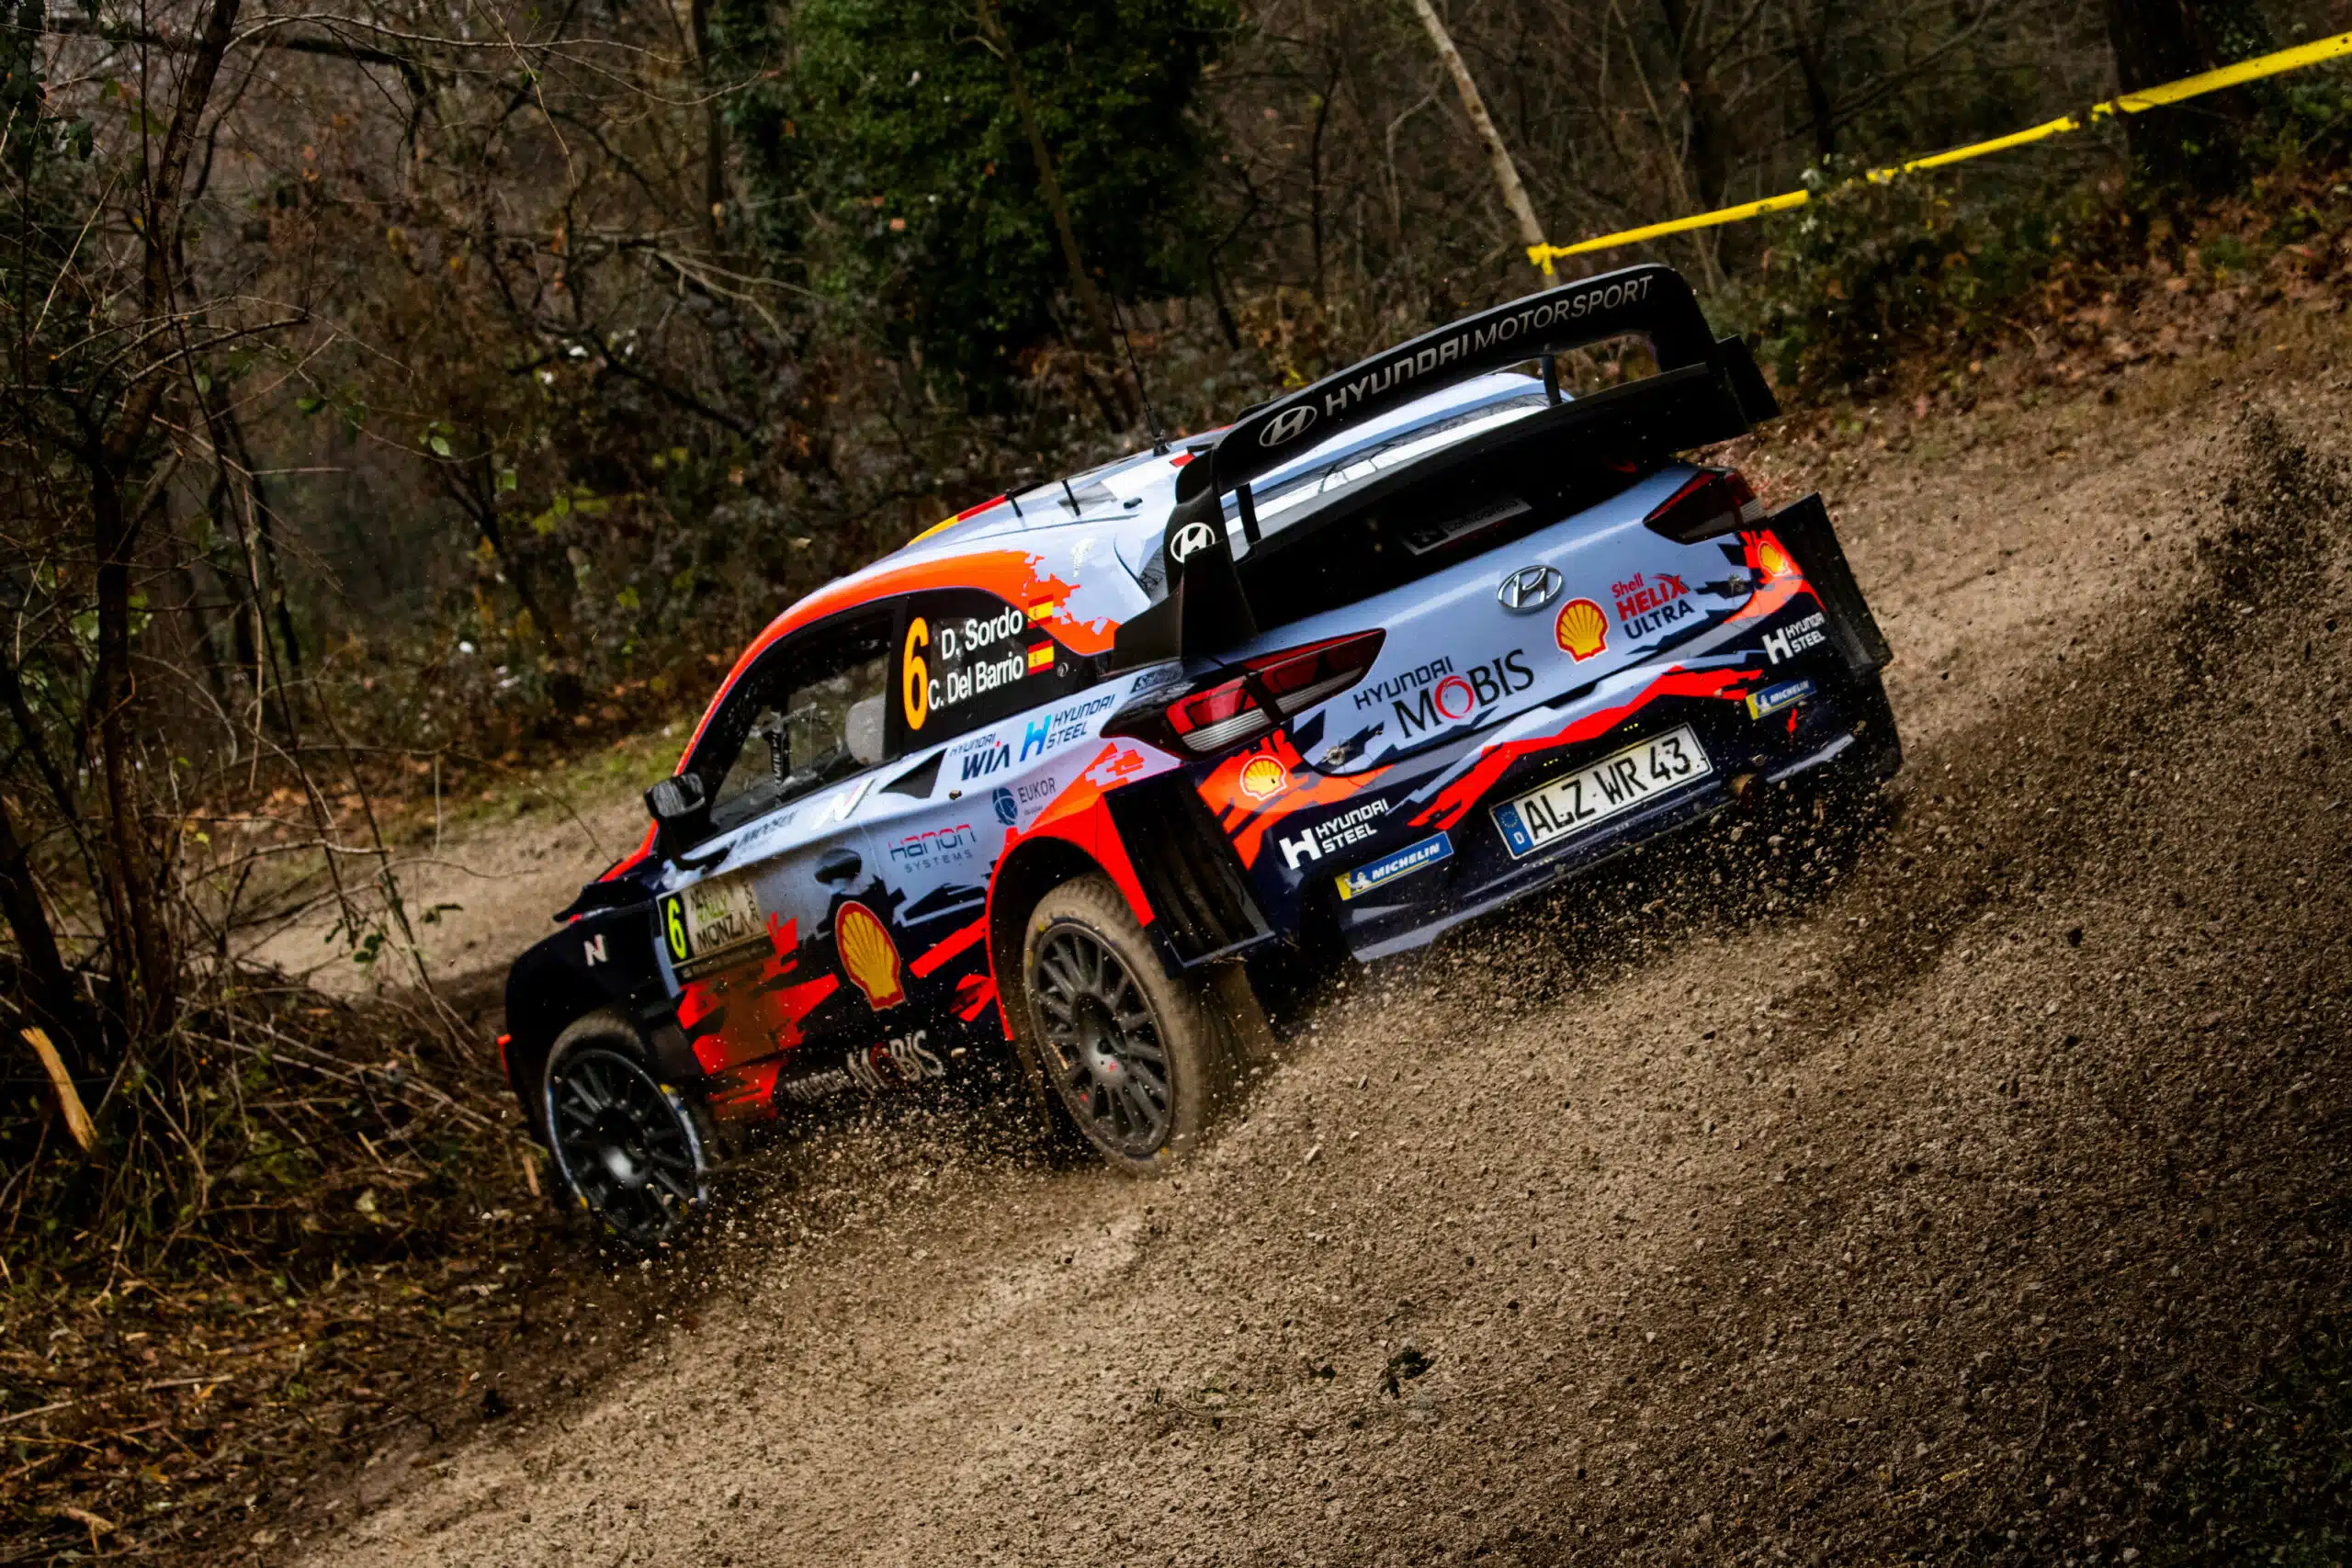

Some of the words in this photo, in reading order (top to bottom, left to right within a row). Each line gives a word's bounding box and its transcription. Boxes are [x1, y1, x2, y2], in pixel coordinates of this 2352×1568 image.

[1325, 333, 1469, 416] HYUNDAI
[1475, 275, 1653, 353] MOTORSPORT
[1611, 572, 1645, 598] Shell
[1615, 573, 1689, 622] HELIX
[942, 628, 960, 660] D.
[965, 606, 1023, 651] Sordo
[1623, 599, 1694, 639] ULTRA
[1785, 612, 1826, 638] HYUNDA
[1791, 630, 1826, 653] STEEL
[903, 616, 929, 730] 6
[928, 679, 944, 710] C.
[947, 666, 972, 704] Del
[976, 651, 1023, 694] Barrio
[1353, 656, 1453, 710] HYUNDAI
[1770, 680, 1809, 704] MICHELIN
[1052, 694, 1115, 728] HYUNDAI
[1391, 649, 1534, 739] MOBIS
[949, 732, 997, 757] HYUNDAI
[1046, 721, 1088, 750] STEEL
[961, 740, 1010, 781] WIA
[1017, 777, 1056, 803] EUKOR
[1524, 779, 1595, 839] ALZ
[1593, 757, 1648, 805] WR
[1650, 737, 1691, 781] 43
[1315, 798, 1389, 839] HYUNDAI
[1321, 823, 1377, 853] STEEL
[1513, 831, 1525, 845] D
[904, 849, 973, 874] SYSTEMS
[1371, 842, 1441, 880] MICHELIN
[667, 897, 687, 959] 6
[695, 912, 754, 951] MONZA
[583, 933, 607, 966] N
